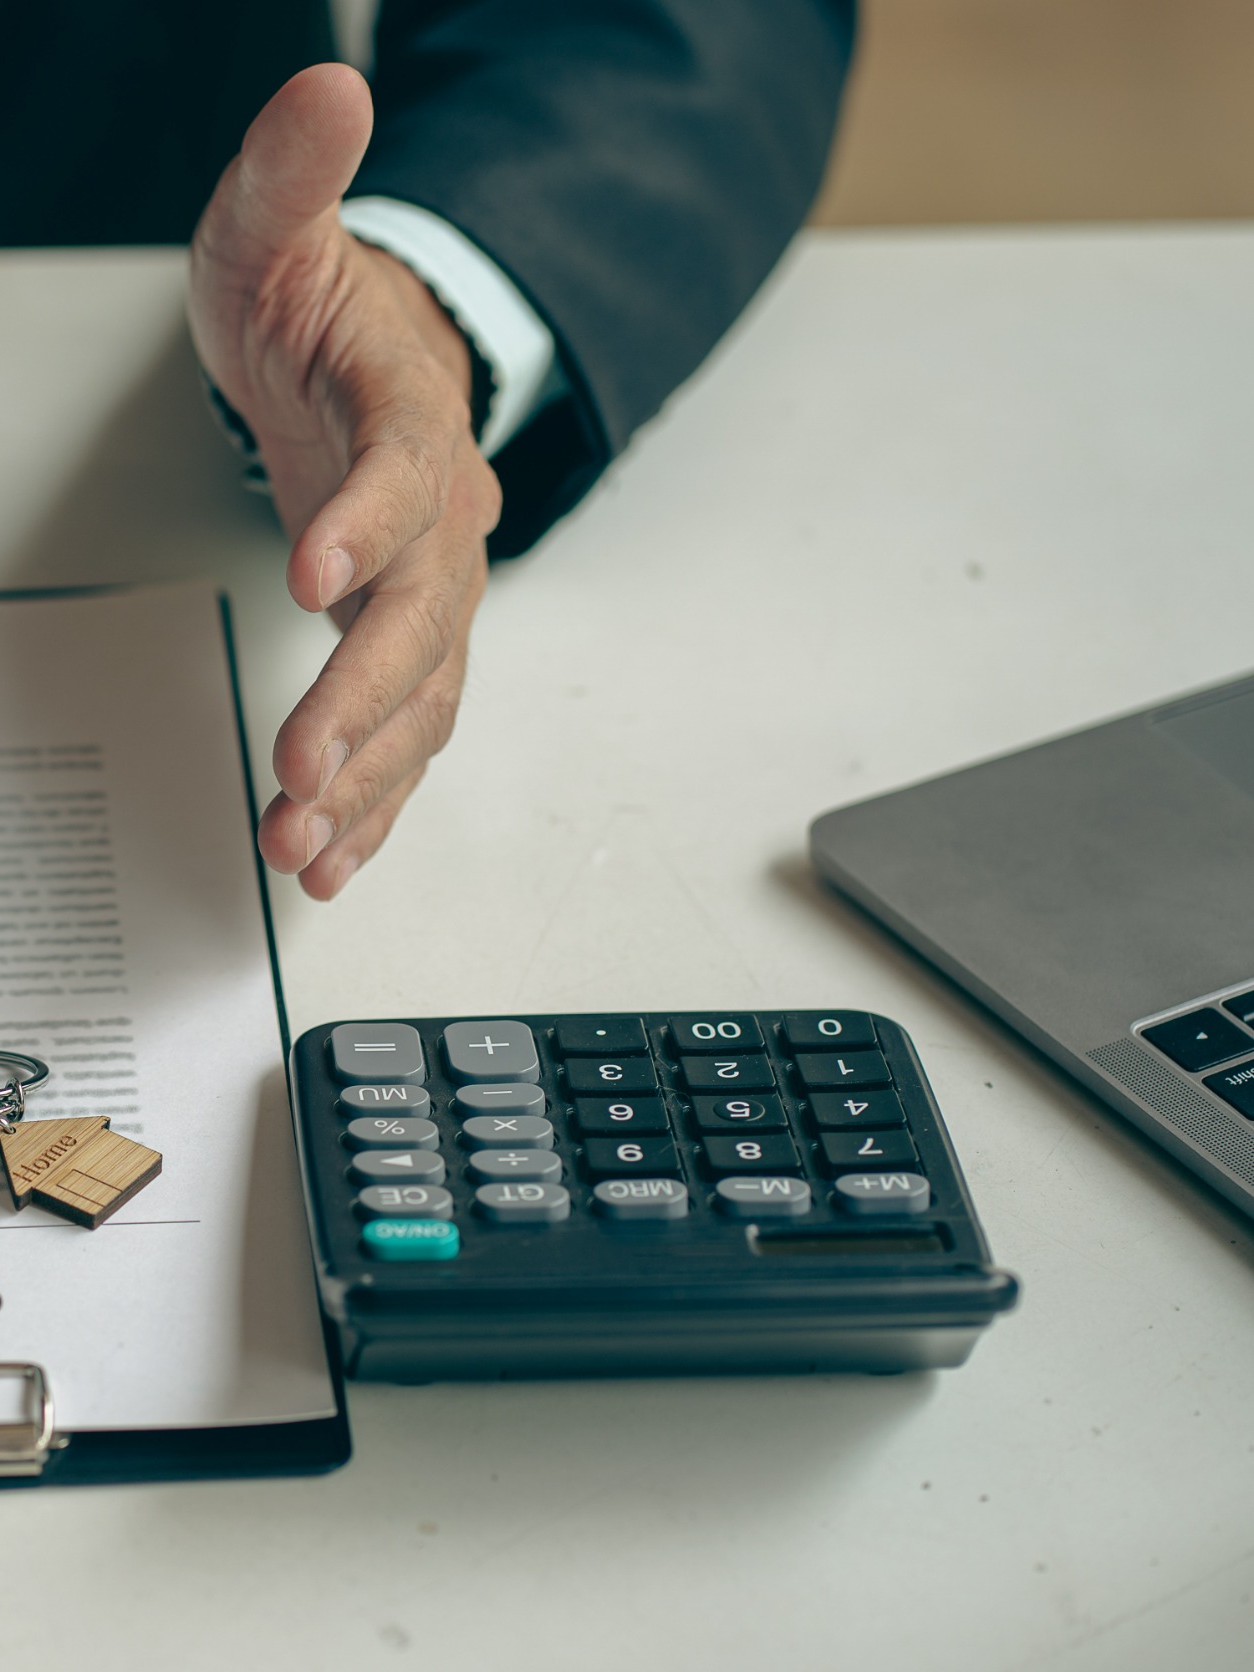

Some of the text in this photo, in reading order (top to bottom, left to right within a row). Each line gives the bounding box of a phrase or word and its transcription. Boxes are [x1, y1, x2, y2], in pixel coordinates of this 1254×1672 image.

[691, 1021, 741, 1040] 00
[817, 1018, 842, 1036] 0
[598, 1064, 623, 1081] 3
[714, 1062, 740, 1079] 2
[837, 1059, 855, 1075] 1
[358, 1087, 407, 1101] MU
[608, 1104, 634, 1121] 6
[726, 1101, 750, 1118] 5
[843, 1099, 869, 1116] 4
[616, 1143, 644, 1162] 9
[735, 1142, 762, 1160] 8
[857, 1137, 883, 1155] 7
[12, 1135, 78, 1183] Home
[608, 1181, 673, 1198] MRC
[853, 1175, 910, 1191] M+
[379, 1187, 428, 1205] CE
[499, 1185, 545, 1201] GT
[374, 1222, 451, 1239] ON/AC
